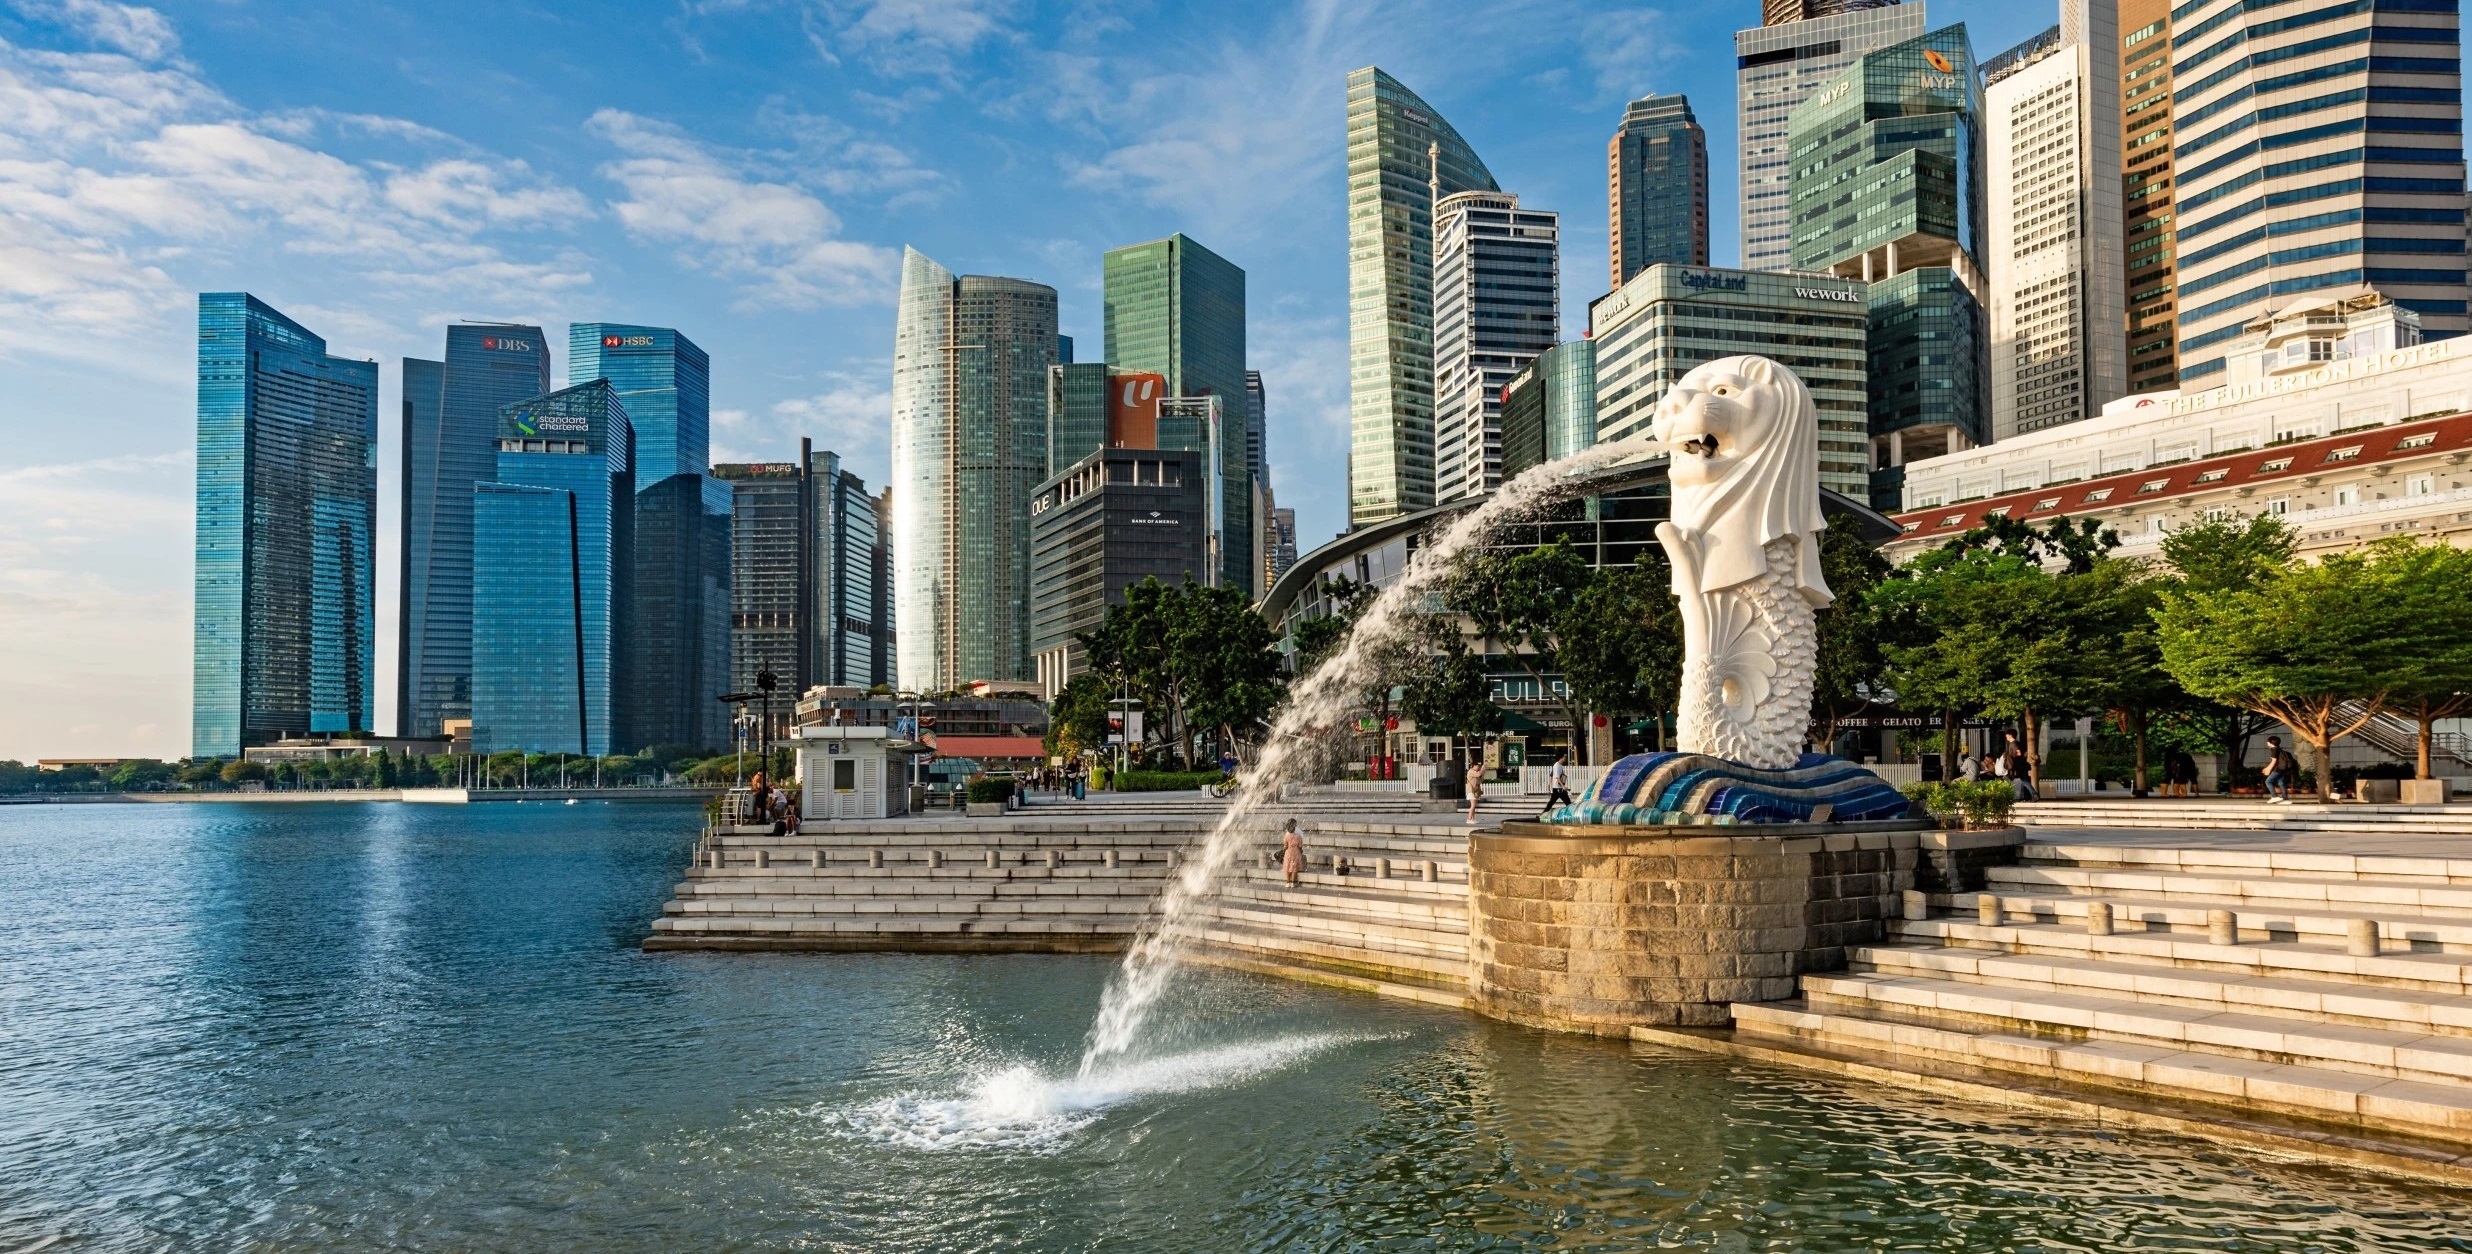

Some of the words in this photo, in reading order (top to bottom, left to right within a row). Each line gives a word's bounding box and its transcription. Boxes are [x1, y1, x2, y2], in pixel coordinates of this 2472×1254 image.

[1921, 75, 1956, 89] MYP
[1820, 81, 1849, 107] MYP
[1404, 109, 1428, 124] Keppel
[1795, 286, 1859, 302] wework
[498, 338, 530, 352] DBS
[623, 336, 654, 346] HSBC
[2162, 394, 2206, 415] THE
[2217, 363, 2351, 403] FULLERTON
[2361, 341, 2454, 376] HOTEL
[539, 415, 586, 424] standard
[539, 423, 589, 432] chartered
[765, 464, 792, 472] MUFG
[1032, 495, 1050, 516] OUE
[1882, 718, 1922, 726] GELATO
